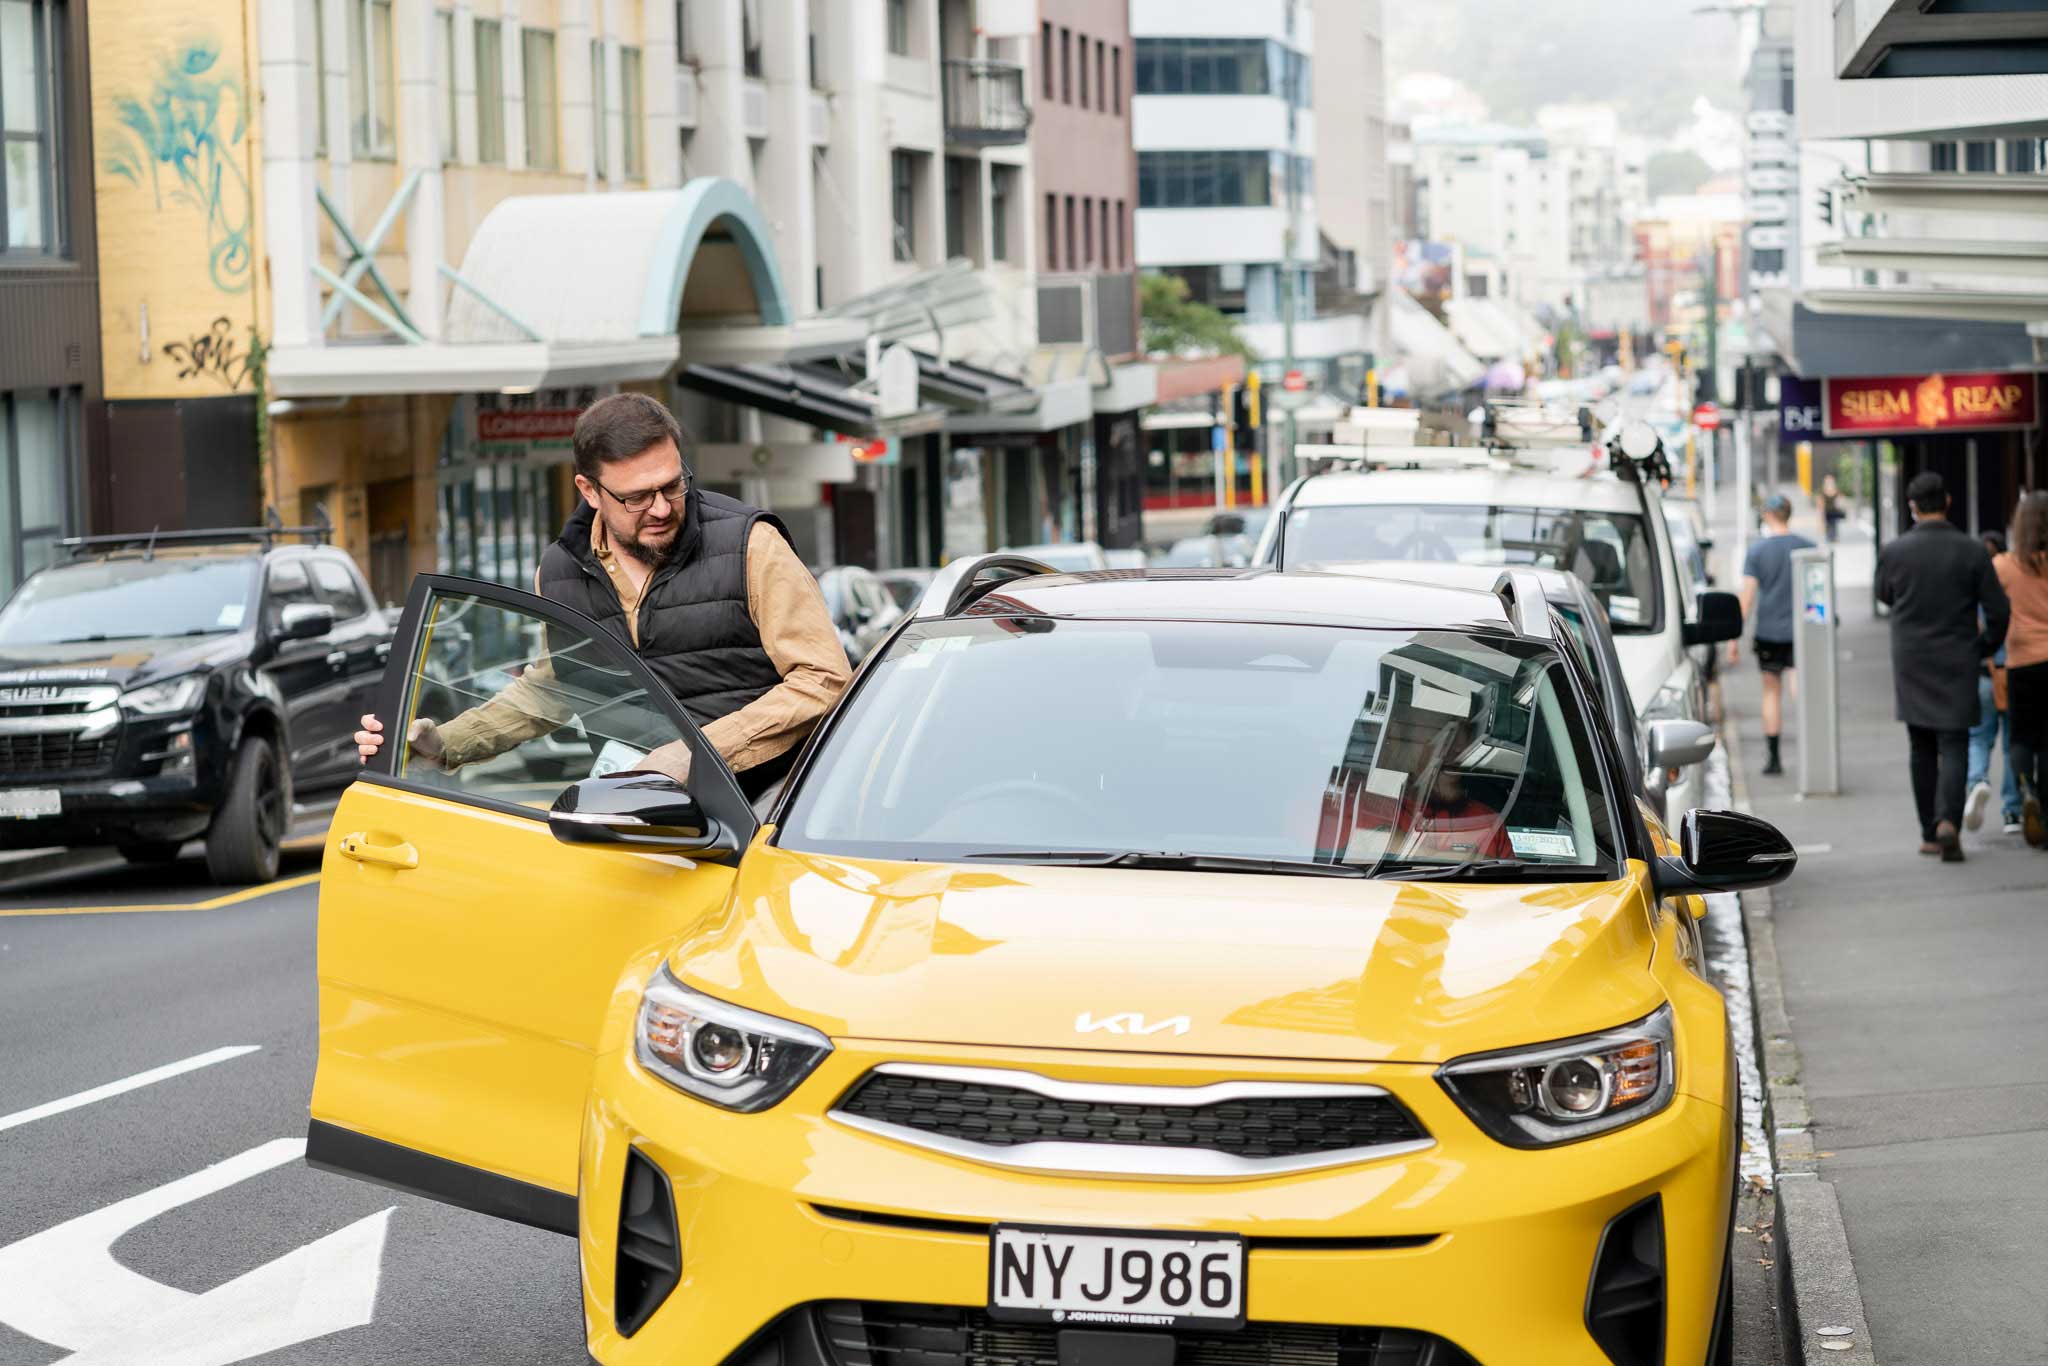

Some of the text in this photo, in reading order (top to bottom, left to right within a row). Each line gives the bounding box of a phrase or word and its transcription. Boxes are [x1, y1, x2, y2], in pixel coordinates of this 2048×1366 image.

[1841, 385, 2022, 417] SIEM REAP
[1075, 1011, 1190, 1036] KIA
[1001, 1242, 1232, 1308] NYJ986
[1067, 1312, 1129, 1324] JOHNSTON
